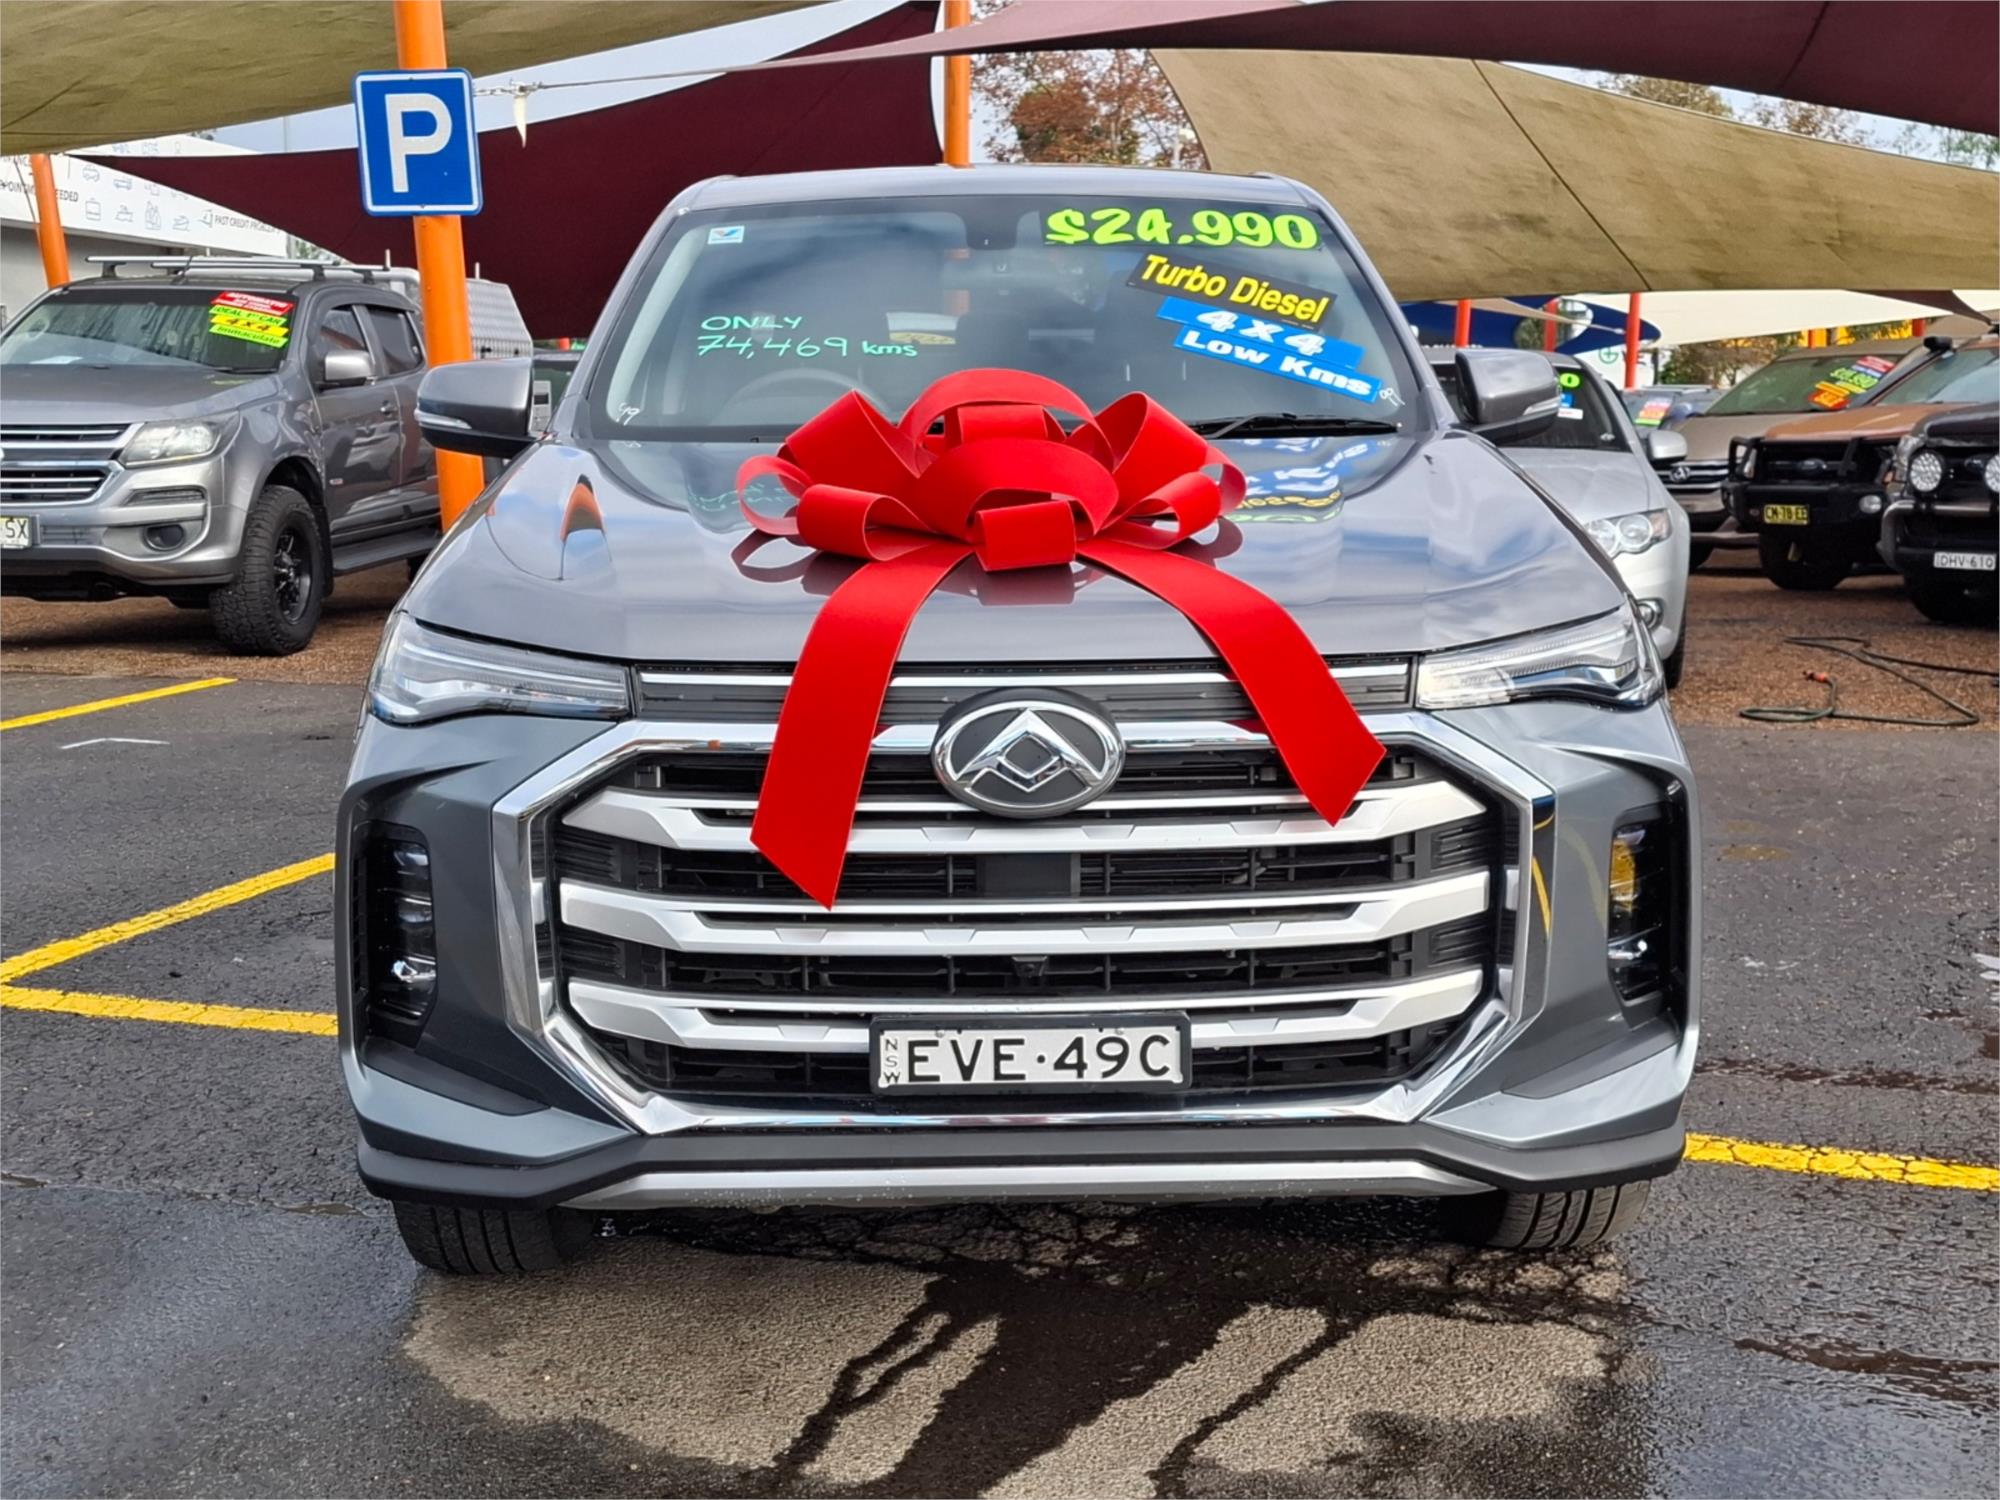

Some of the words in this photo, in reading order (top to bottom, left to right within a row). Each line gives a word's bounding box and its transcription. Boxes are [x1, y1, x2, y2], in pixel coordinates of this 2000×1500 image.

[384, 93, 452, 193] P
[1045, 208, 1318, 250] $24.990
[1140, 253, 1228, 297] Turbo
[1228, 276, 1330, 323] Diesel
[701, 316, 803, 331] ONLY
[697, 334, 848, 359] 74,469
[861, 340, 919, 358] kms
[1279, 355, 1373, 397] Kms
